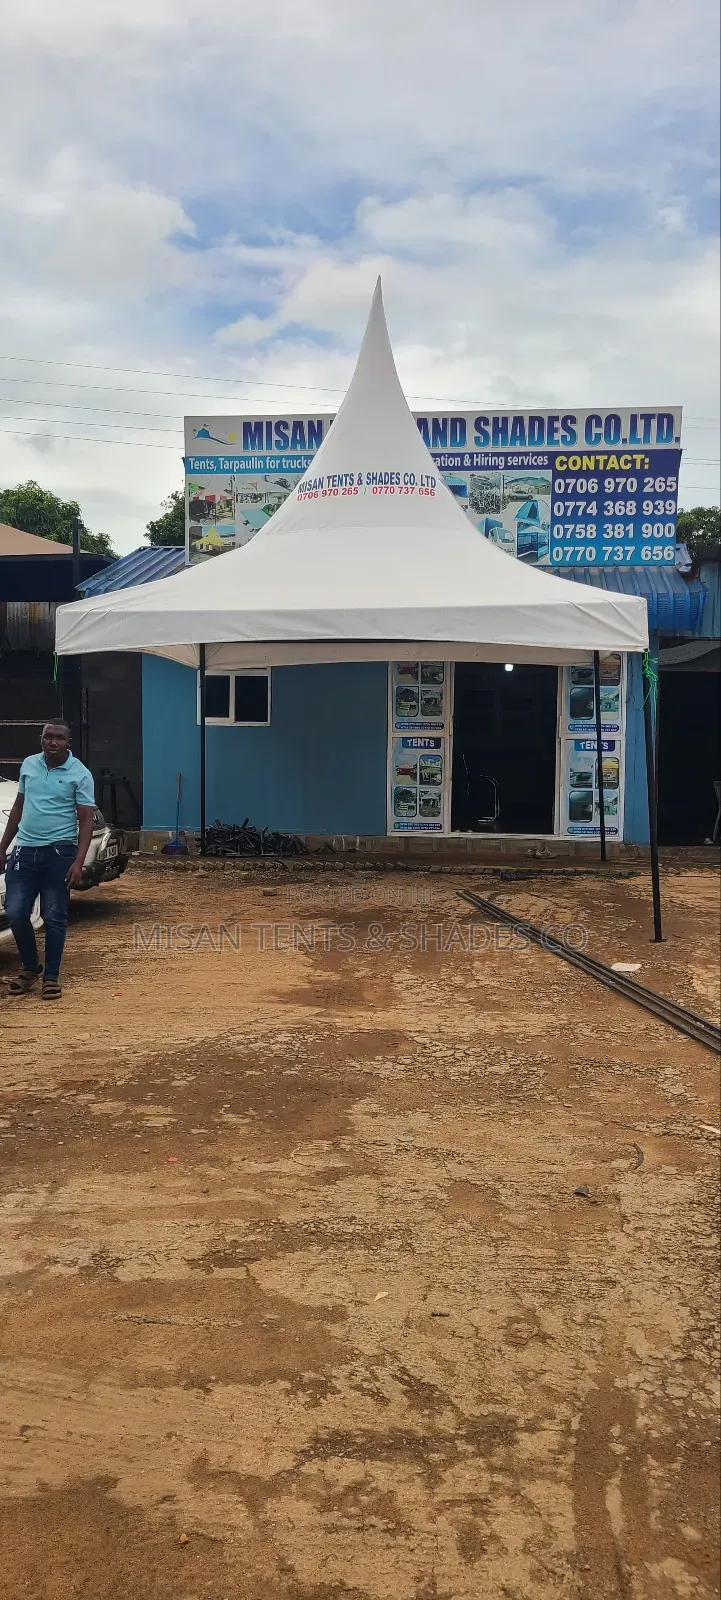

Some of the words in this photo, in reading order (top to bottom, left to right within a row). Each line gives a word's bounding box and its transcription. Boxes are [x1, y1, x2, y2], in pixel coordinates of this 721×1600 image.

[242, 420, 323, 451] MISAN
[416, 417, 467, 449] AND
[473, 416, 578, 448] SHADES
[584, 413, 680, 447] CO.LTD.
[189, 458, 217, 471] Tents,
[218, 457, 264, 472] Tarpaulin
[266, 459, 280, 469] for
[432, 454, 460, 467] ation
[463, 454, 471, 466] &
[474, 454, 505, 469] Hiring
[507, 453, 548, 466] services
[555, 454, 650, 471] CONTACT:
[297, 477, 324, 494] MISAN
[327, 473, 355, 488] TENTS
[357, 472, 363, 486] &
[366, 472, 400, 486] SHADES
[403, 472, 417, 486] CO.
[420, 474, 436, 488] LTD
[554, 478, 599, 494] 0706
[604, 478, 638, 494] 970
[642, 477, 677, 493] 265
[297, 490, 319, 501] 0706
[321, 488, 339, 498] 970
[341, 486, 359, 496] 265
[372, 486, 395, 495] 0770
[398, 486, 415, 495] 737
[418, 487, 436, 497] 656
[553, 501, 598, 517] 0774
[603, 500, 637, 516] 368
[642, 500, 677, 516] 939
[552, 524, 597, 539] 0758
[602, 523, 635, 539] 381
[641, 523, 676, 538] 900
[552, 546, 597, 562] 0770
[602, 546, 636, 561] 737
[640, 546, 675, 561] 656
[406, 738, 435, 747] TENTS
[579, 741, 609, 750] TENS
